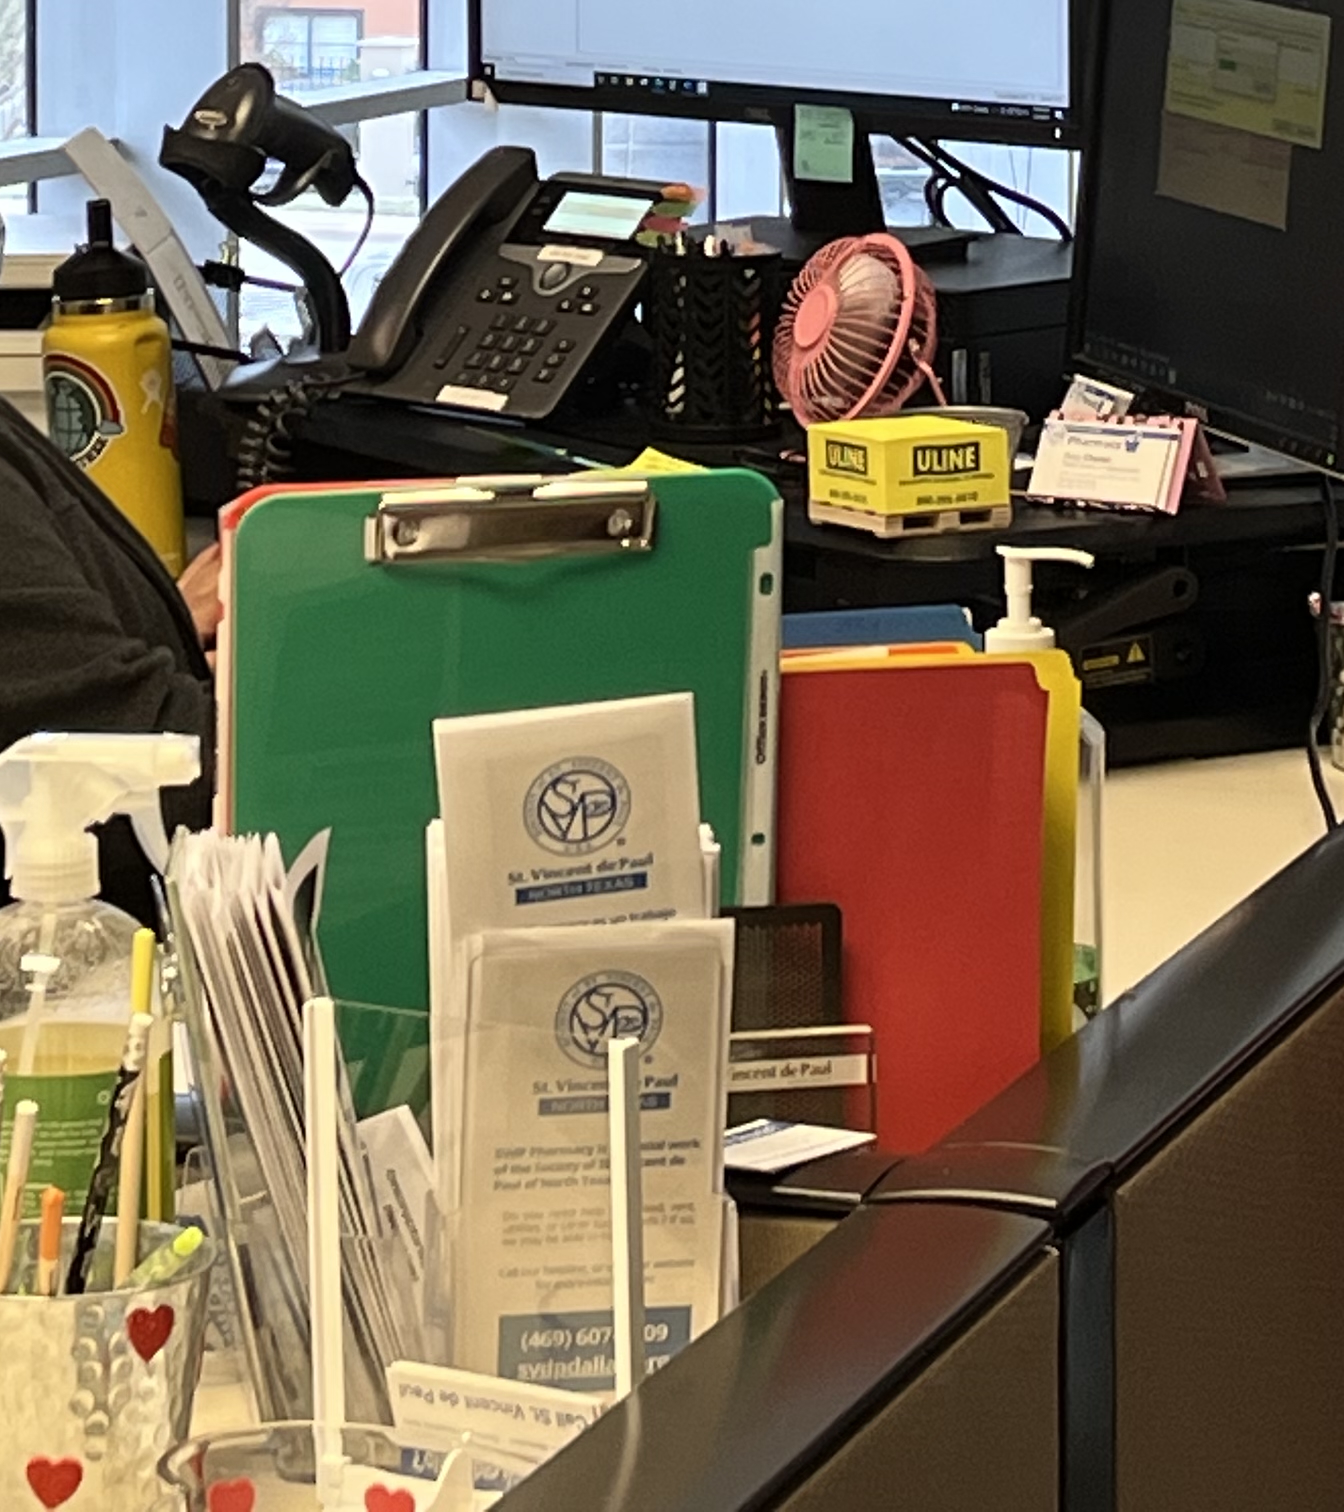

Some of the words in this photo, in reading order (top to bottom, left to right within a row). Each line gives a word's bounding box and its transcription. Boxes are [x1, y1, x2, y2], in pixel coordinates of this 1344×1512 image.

[828, 444, 866, 472] ULINE
[916, 445, 977, 472] ULINE
[508, 870, 529, 884] St.
[530, 862, 593, 881] Vincent
[596, 857, 614, 872] de
[617, 851, 654, 869] Paul
[529, 882, 583, 901] NORTH
[585, 875, 635, 895] TEXAS
[731, 1066, 777, 1083] incent
[780, 1064, 797, 1079] de
[800, 1060, 833, 1078] Paul
[533, 1080, 554, 1093] St.
[644, 1074, 679, 1089] Paul
[520, 1328, 573, 1352] (469)
[398, 1382, 435, 1405] Paul
[439, 1389, 460, 1408] de
[464, 1394, 525, 1421] Vincent
[525, 1405, 552, 1426] St.
[556, 1410, 589, 1430] Call
